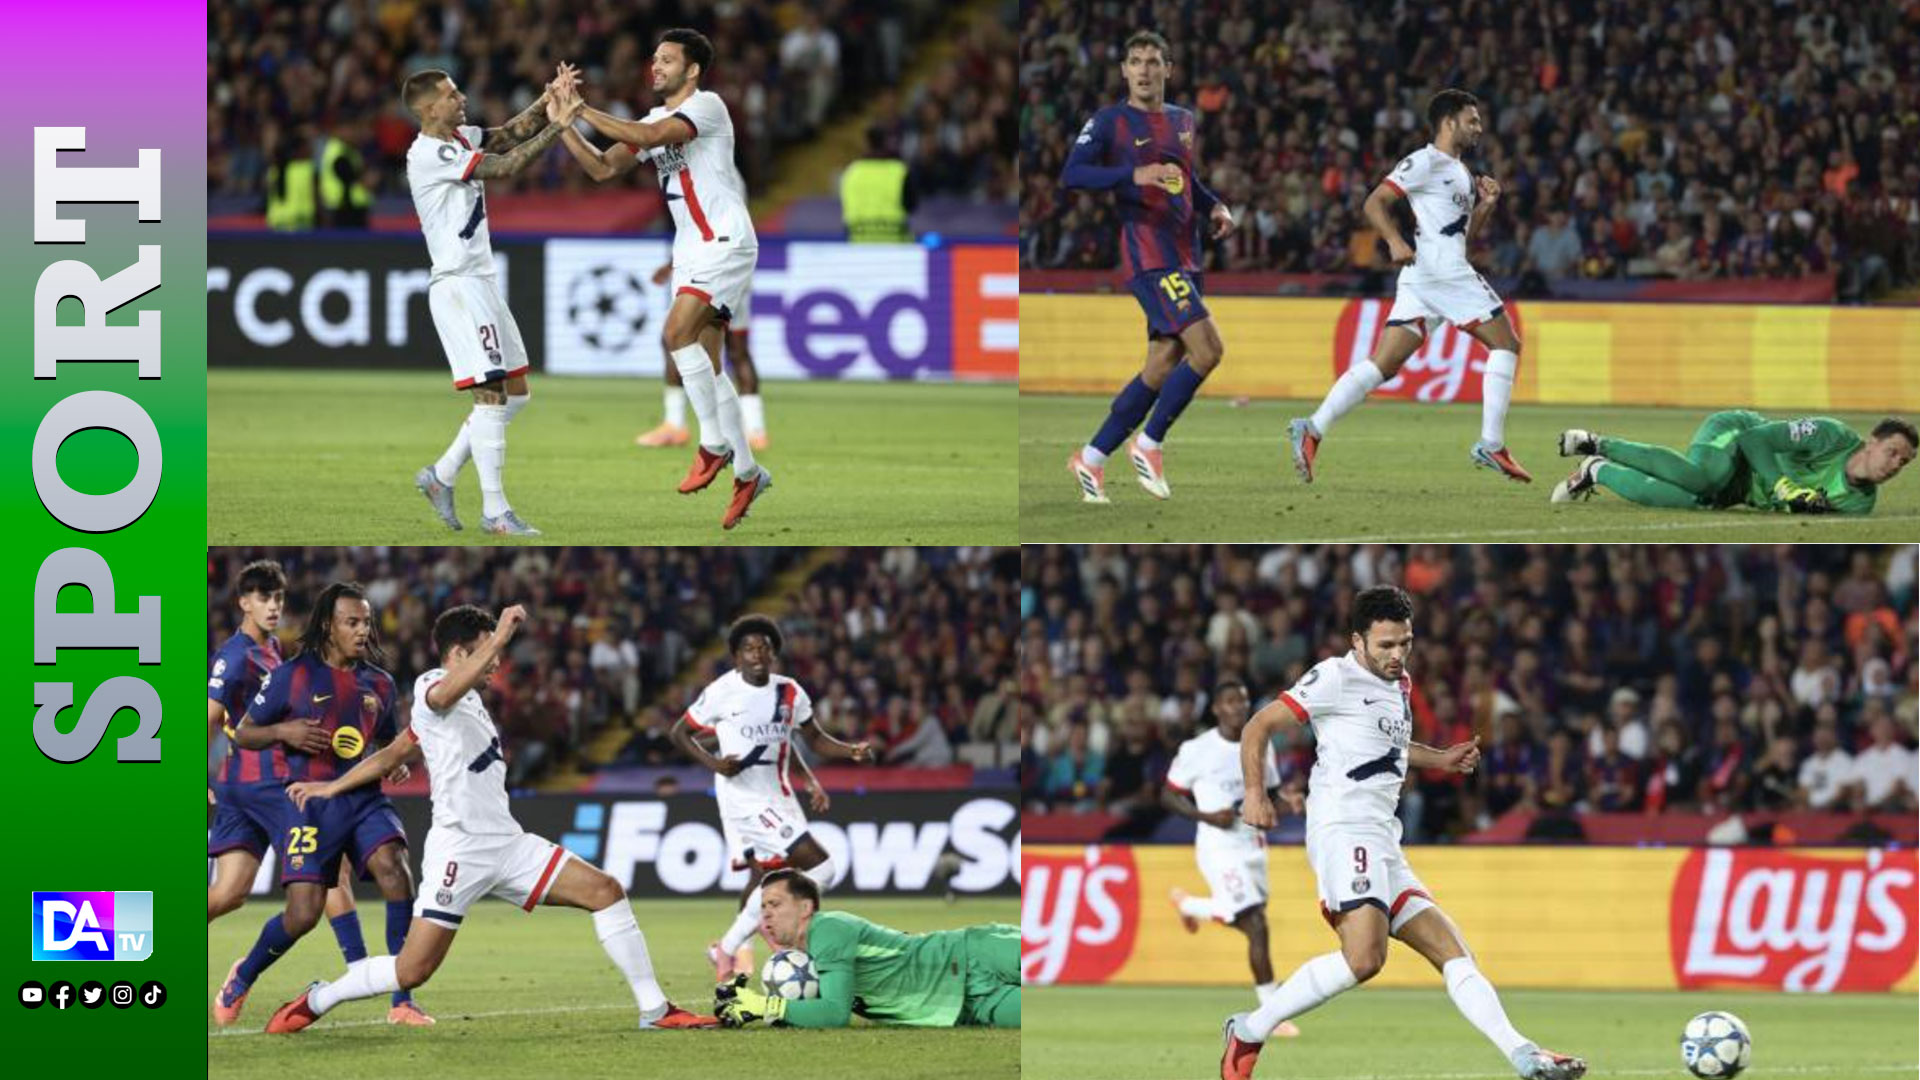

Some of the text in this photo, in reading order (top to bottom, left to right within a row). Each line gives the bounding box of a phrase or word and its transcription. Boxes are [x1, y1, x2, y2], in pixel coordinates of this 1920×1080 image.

[1160, 272, 1191, 300] 15
[479, 324, 500, 351] 21
[759, 807, 783, 829] 41
[287, 826, 318, 854] 23
[443, 861, 458, 887] 9
[1354, 846, 1367, 874] 9
[1683, 846, 1914, 992] Lay's
